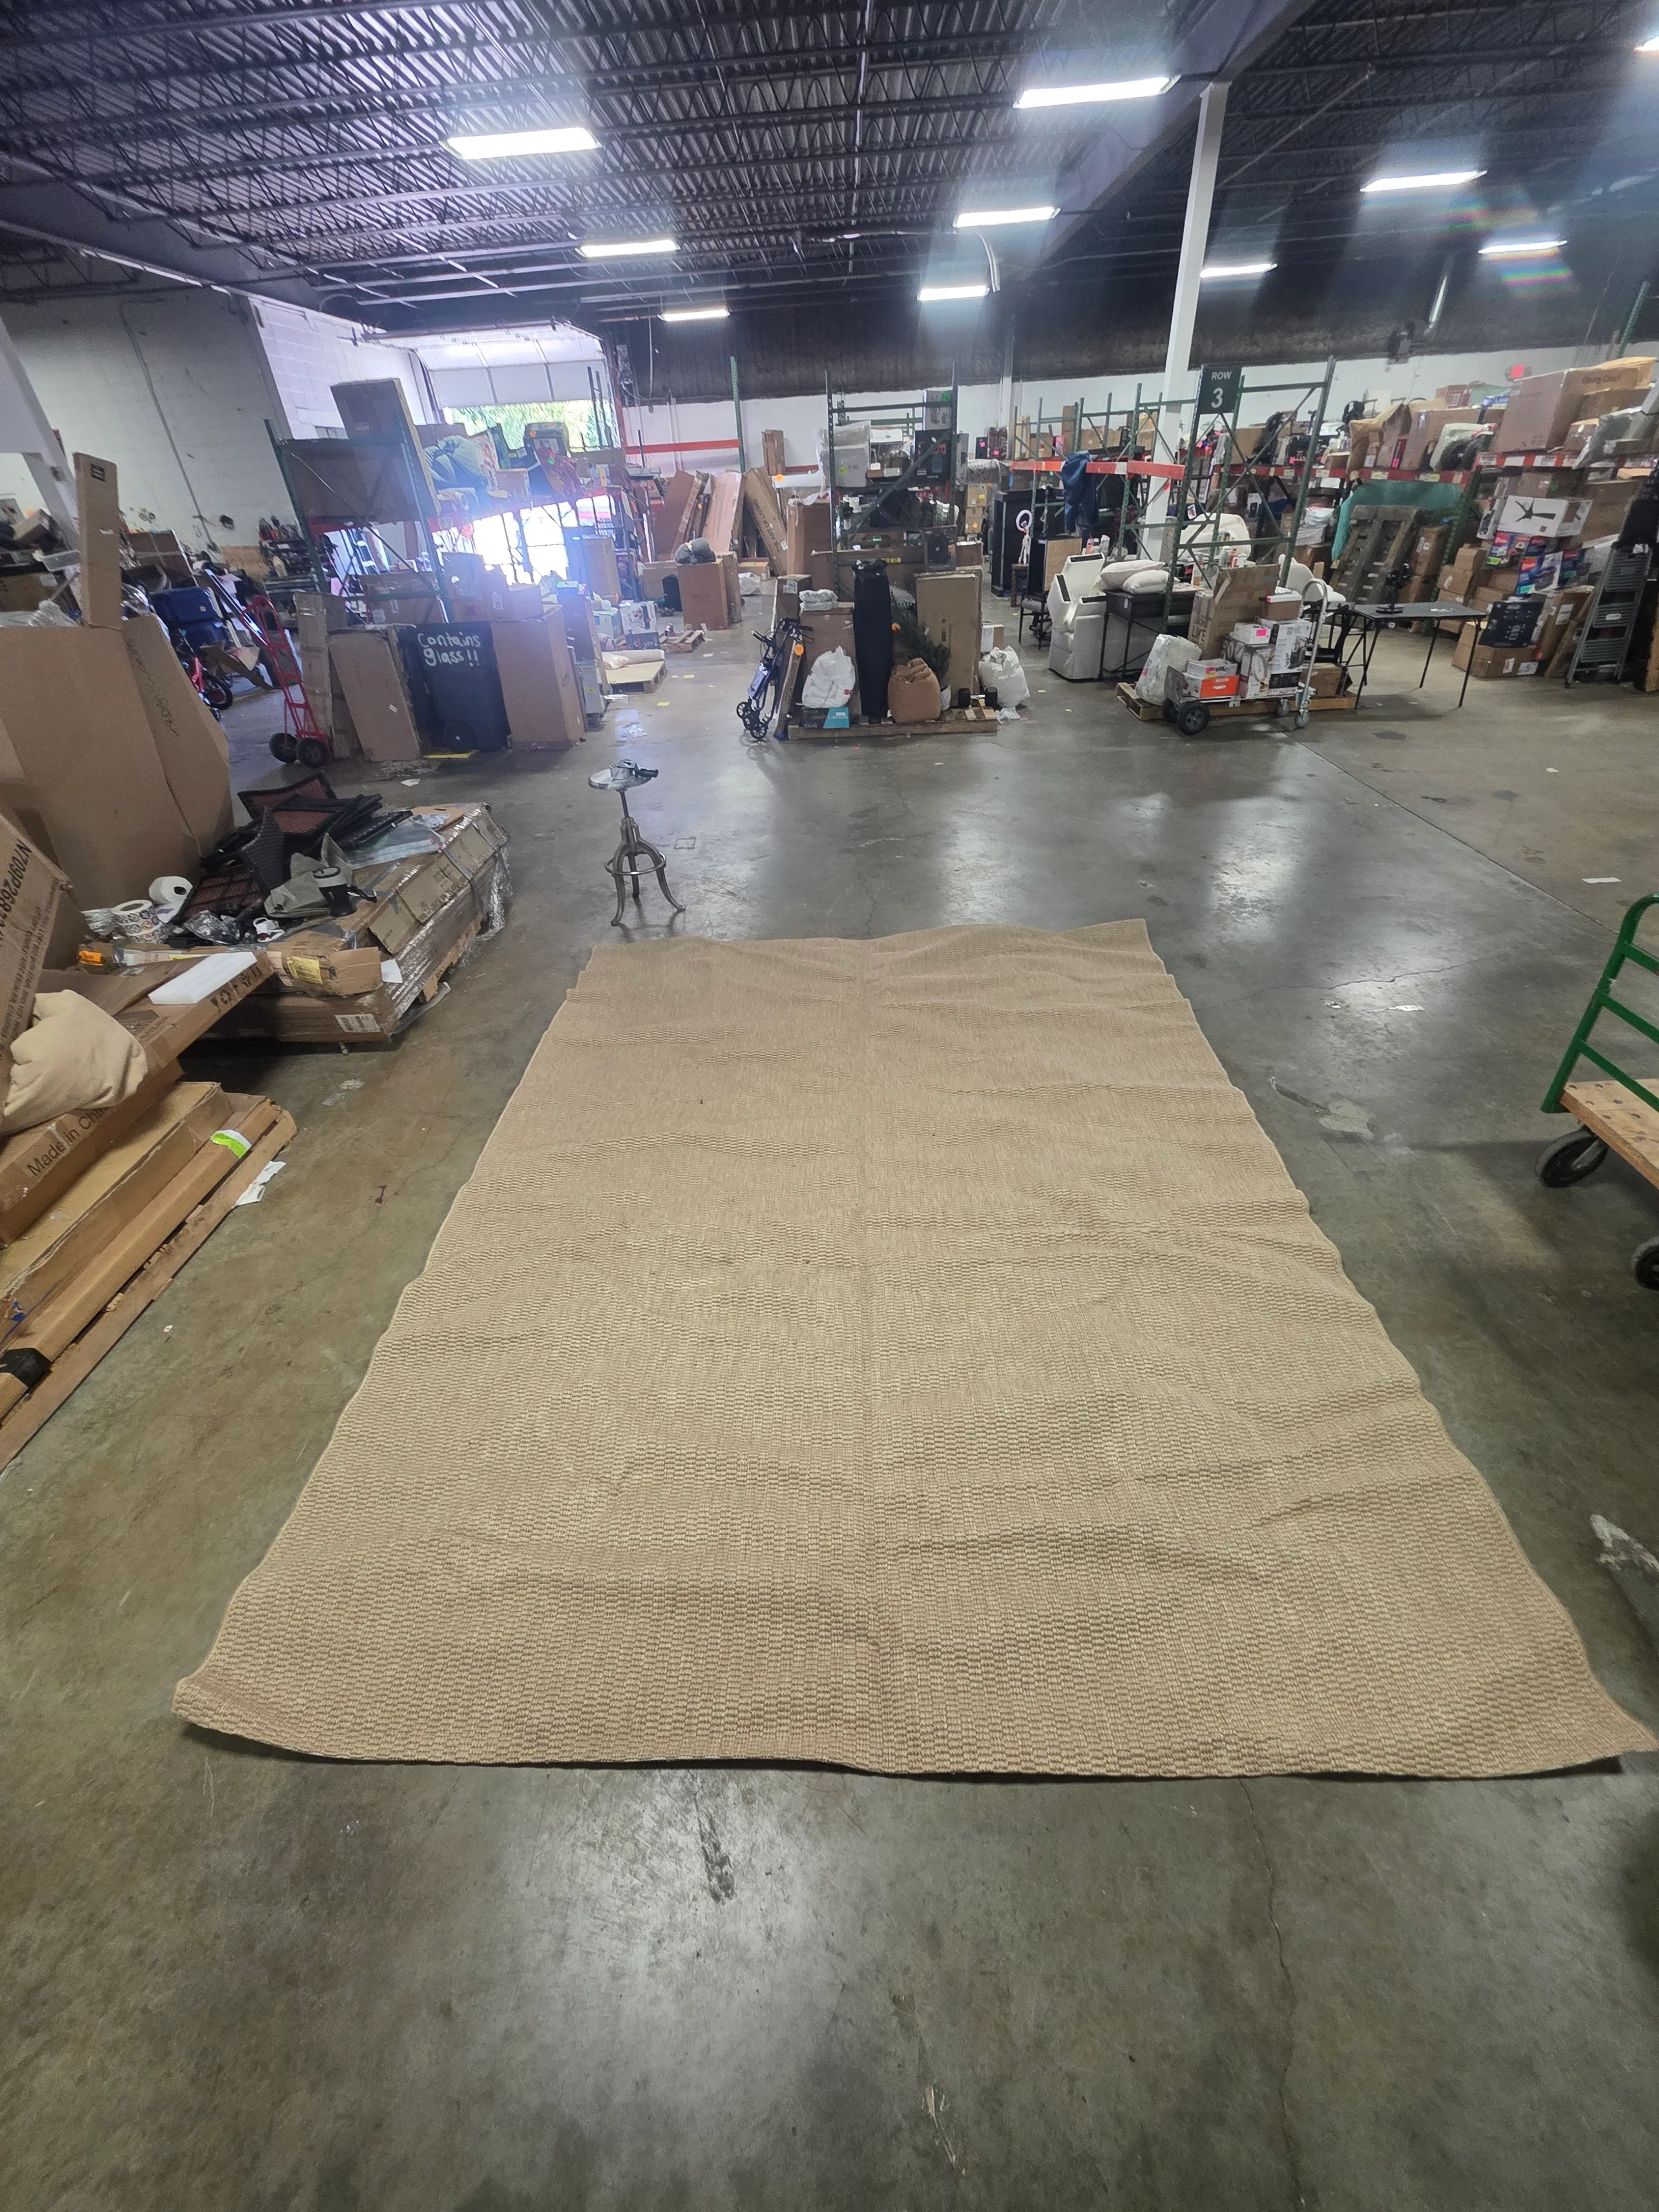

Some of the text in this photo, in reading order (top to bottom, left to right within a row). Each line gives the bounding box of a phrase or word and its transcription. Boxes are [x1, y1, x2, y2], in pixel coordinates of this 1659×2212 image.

[1212, 371, 1232, 380] ROW
[1211, 388, 1223, 408] 3
[418, 632, 481, 648] Contains
[0, 839, 32, 941] N709P268
[27, 1141, 65, 1176] Made
[64, 1129, 81, 1144] in
